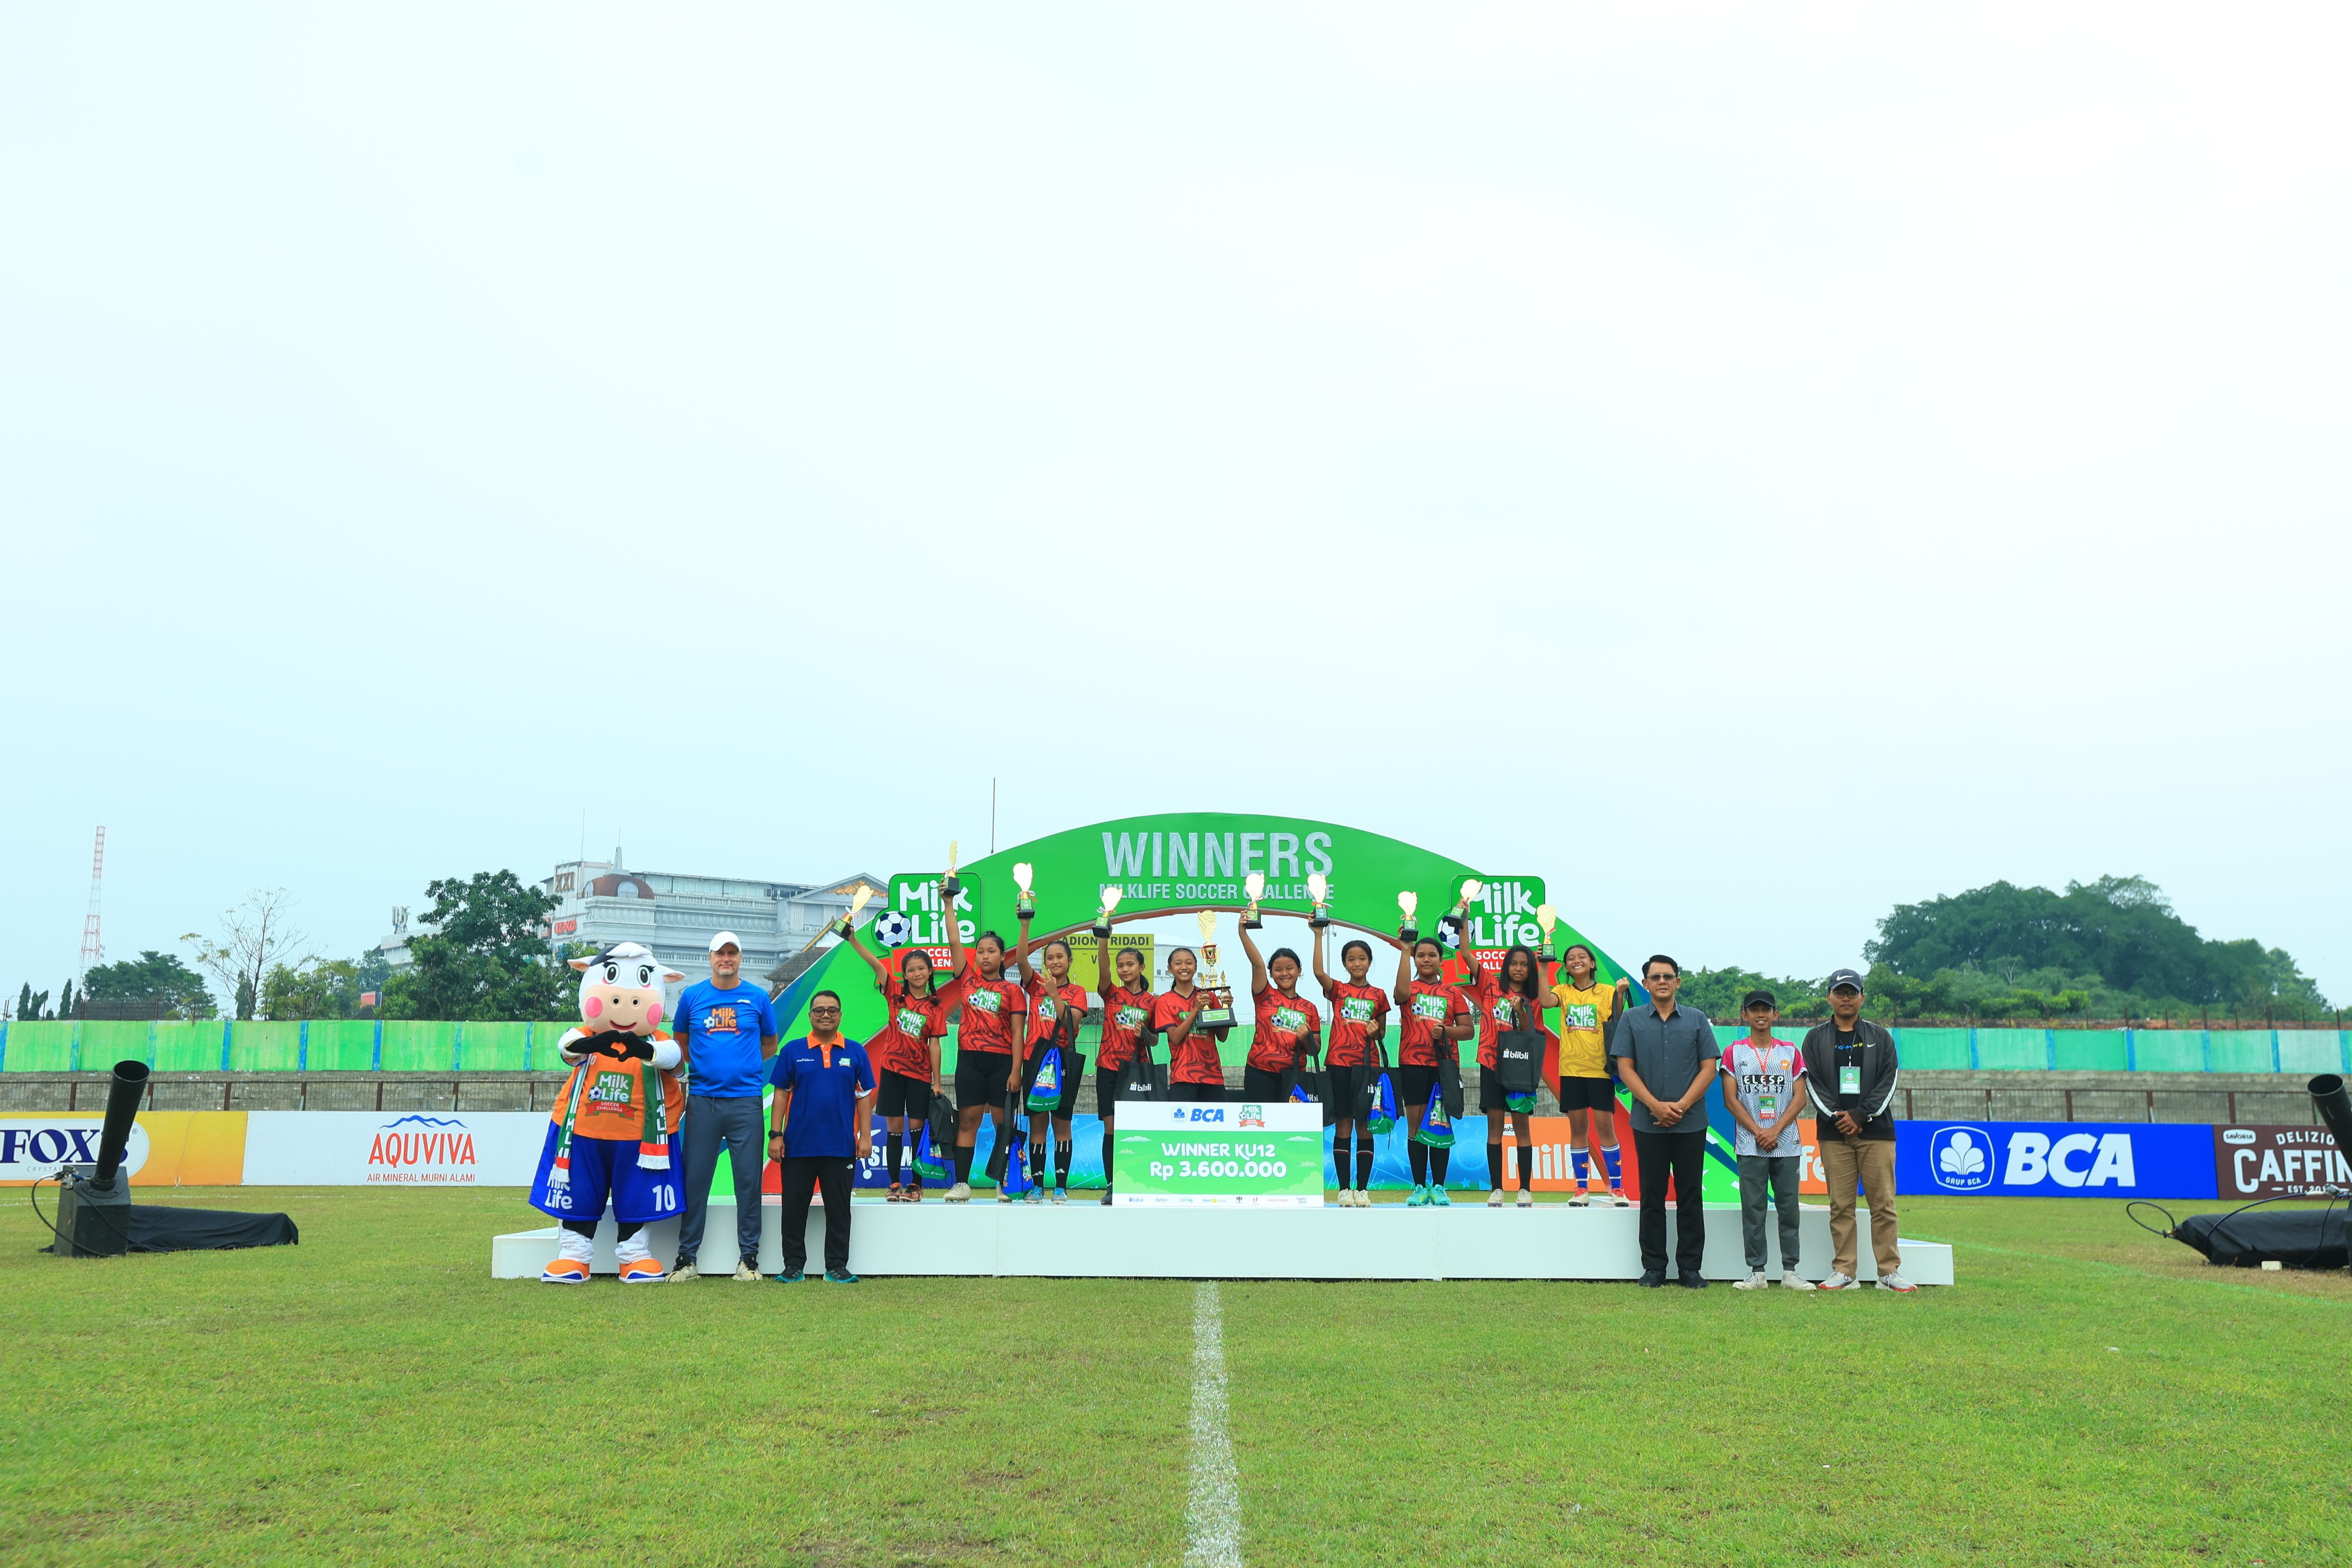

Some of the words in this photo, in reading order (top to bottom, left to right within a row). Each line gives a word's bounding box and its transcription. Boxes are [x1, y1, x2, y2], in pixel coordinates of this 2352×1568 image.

[1102, 832, 1333, 878] WINNERS
[1099, 884, 1170, 899] MLKLIFE
[1176, 884, 1237, 899] SOCCER
[1243, 884, 1334, 899] CALLENE
[1468, 882, 1537, 915] Milk
[911, 912, 975, 944] Life
[1474, 914, 1540, 947] Life
[1061, 936, 1098, 946] ADION
[1110, 936, 1149, 946] RIDADI
[1475, 951, 1506, 960] SOCC
[978, 989, 998, 1003] Milk
[1420, 996, 1444, 1009] Milk
[979, 998, 998, 1011] Life
[1045, 998, 1055, 1009] Mi
[1348, 999, 1372, 1012] Milk
[1499, 1000, 1513, 1012] Mi
[1570, 1005, 1594, 1016] Milk
[712, 1007, 736, 1018] Milk
[900, 1011, 922, 1027] Milk
[1046, 1008, 1057, 1019] Lif
[1125, 1007, 1145, 1021] Milk
[1281, 1009, 1304, 1024] Milk
[1350, 1009, 1370, 1021] Life
[1423, 1005, 1444, 1019] Life
[715, 1017, 737, 1027] Life
[1282, 1018, 1299, 1030] Lif
[1574, 1015, 1595, 1027] Life
[901, 1021, 920, 1036] Life
[1510, 1051, 1529, 1060] blibli
[599, 1074, 629, 1090] Milk
[1743, 1075, 1784, 1085] ELESP
[601, 1088, 629, 1102] Life
[1190, 1108, 1224, 1122] BCA
[2275, 1130, 2335, 1146] DELIZIO
[0, 1129, 129, 1164] FOX
[368, 1133, 476, 1168] AQUVIVA
[1161, 1143, 1231, 1157] WINNER
[1235, 1143, 1276, 1161] KU12
[2003, 1132, 2136, 1188] BCA
[1150, 1161, 1174, 1181] Rp
[1178, 1160, 1287, 1178] 3.600.000
[2234, 1148, 2352, 1193] CAFFIN
[367, 1174, 380, 1182] AIR
[383, 1174, 418, 1182] MINERAL
[421, 1174, 447, 1182] MURNI
[449, 1174, 476, 1182] ALAMI
[1945, 1176, 1966, 1186] GRUP
[1968, 1177, 1982, 1185] BCA
[544, 1189, 572, 1209] Life
[652, 1184, 676, 1212] 10
